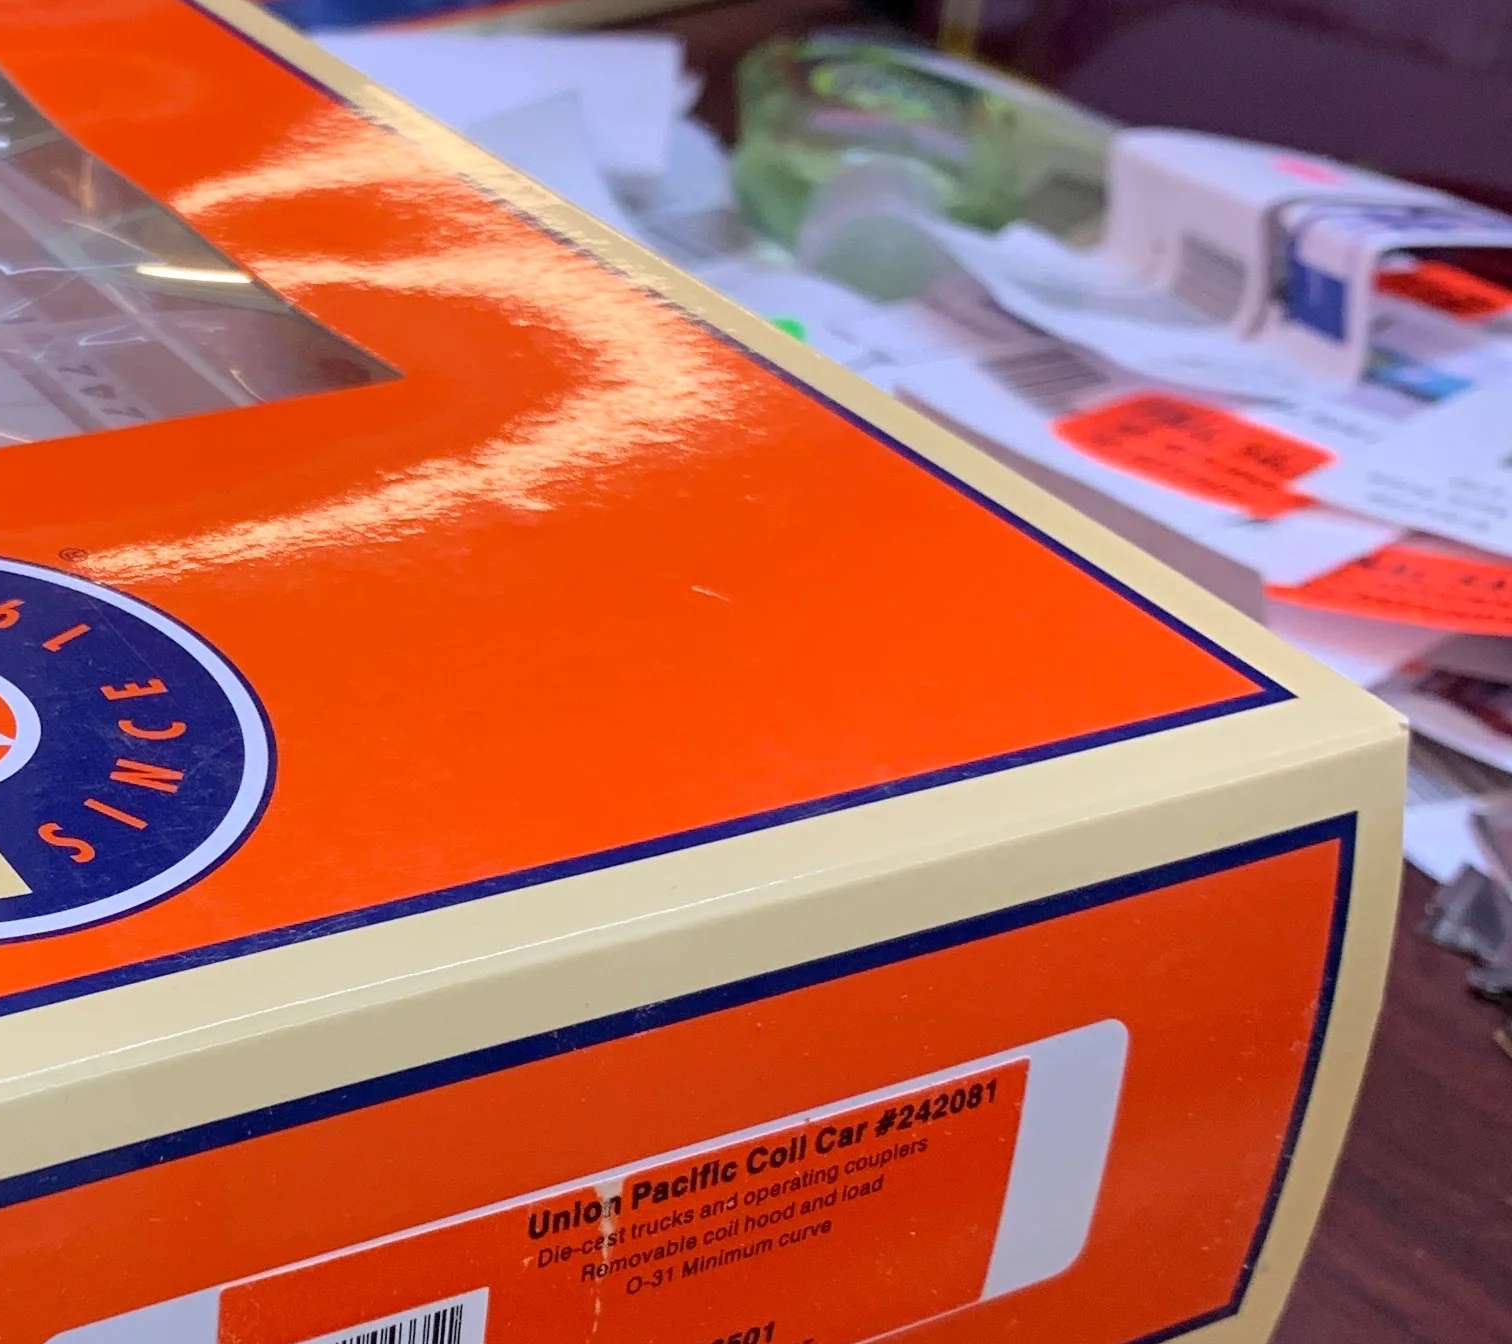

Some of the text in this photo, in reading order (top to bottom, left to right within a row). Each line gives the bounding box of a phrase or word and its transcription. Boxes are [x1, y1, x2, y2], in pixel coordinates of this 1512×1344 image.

[38, 676, 188, 864] SINCE
[528, 1195, 623, 1240] Union
[631, 1159, 738, 1211] Pacific
[815, 1121, 868, 1155] Car
[874, 1079, 998, 1138] #242081
[538, 1137, 929, 1268] Die-cast trucks and operating couplers
[580, 1174, 885, 1284] Removable coil hood and load
[626, 1219, 833, 1296] O-31 Minimum curve
